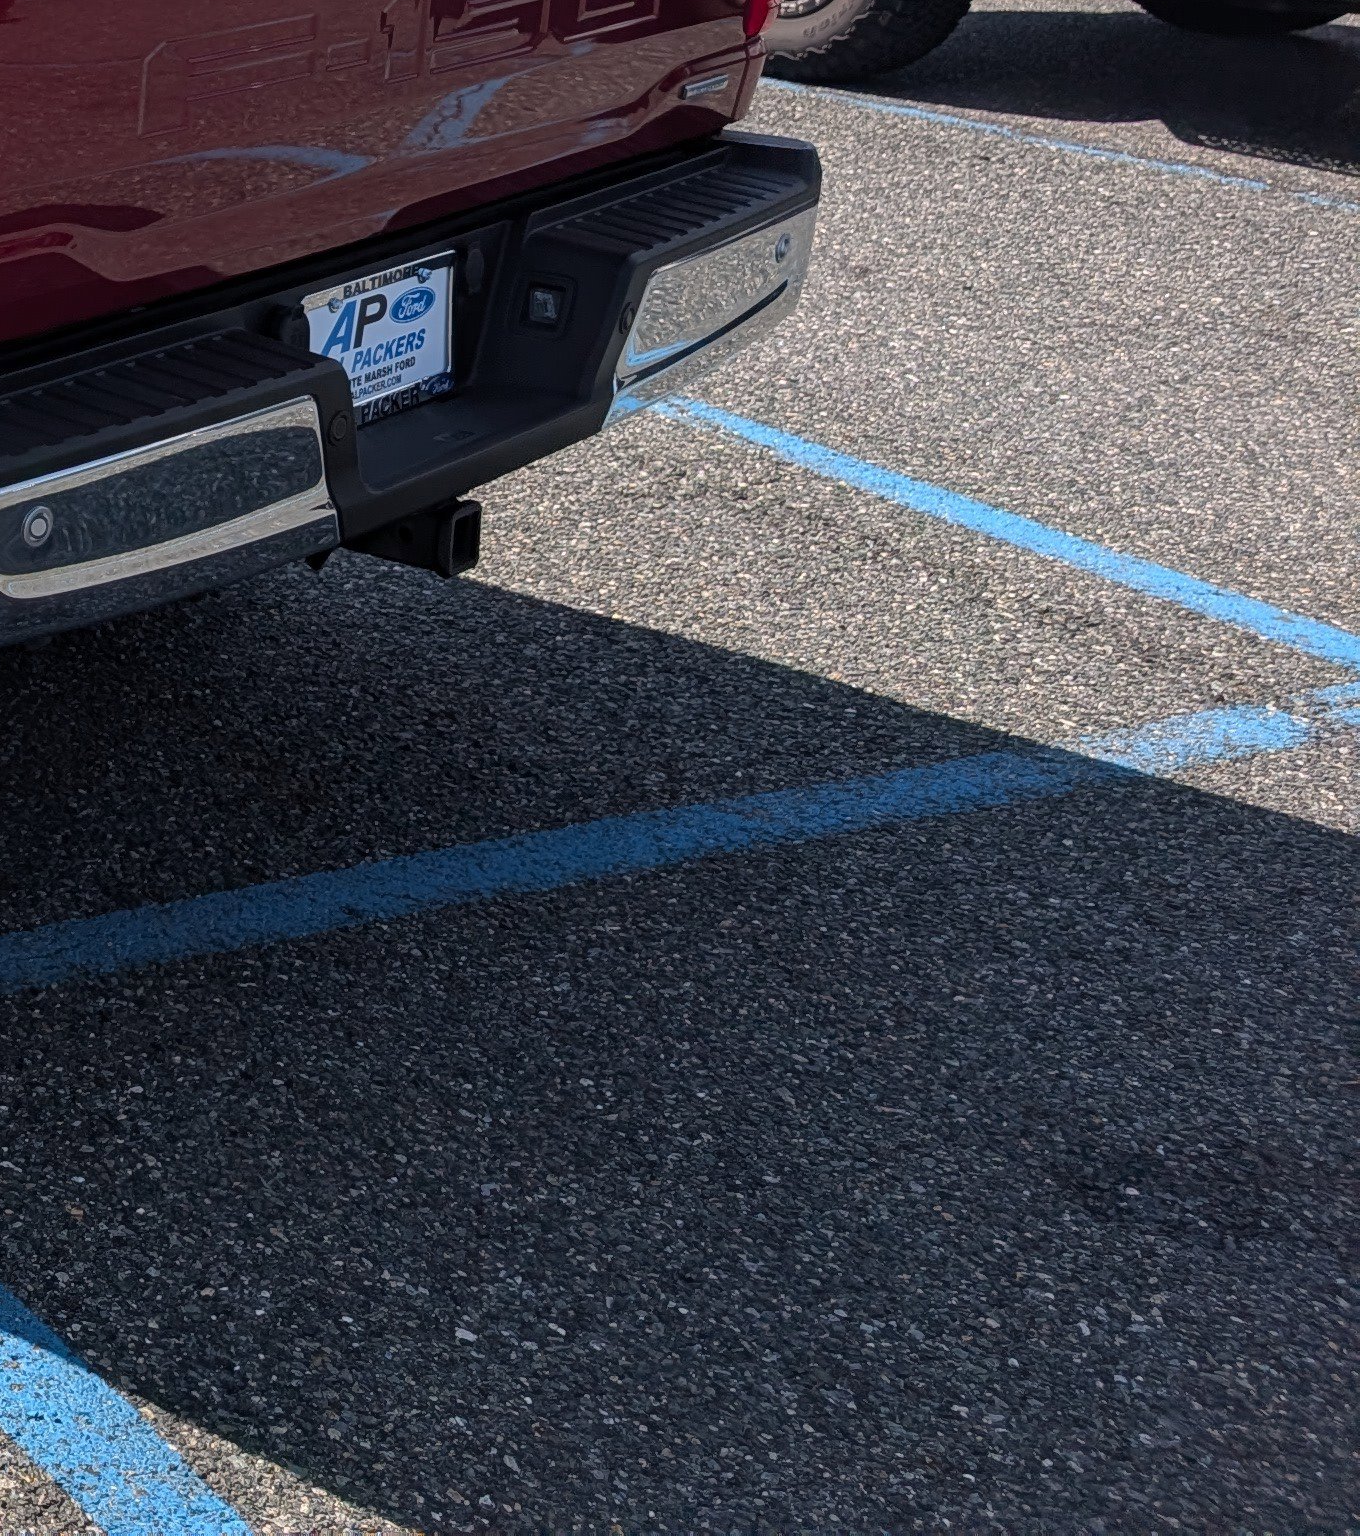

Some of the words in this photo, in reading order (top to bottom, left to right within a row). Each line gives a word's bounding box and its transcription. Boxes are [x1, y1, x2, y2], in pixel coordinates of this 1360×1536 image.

[343, 265, 420, 299] BALTIMORE
[396, 291, 429, 319] Ford
[321, 293, 387, 357] AP
[351, 328, 426, 373] PACKERS
[364, 363, 393, 383] MARSH
[394, 356, 416, 373] FORD
